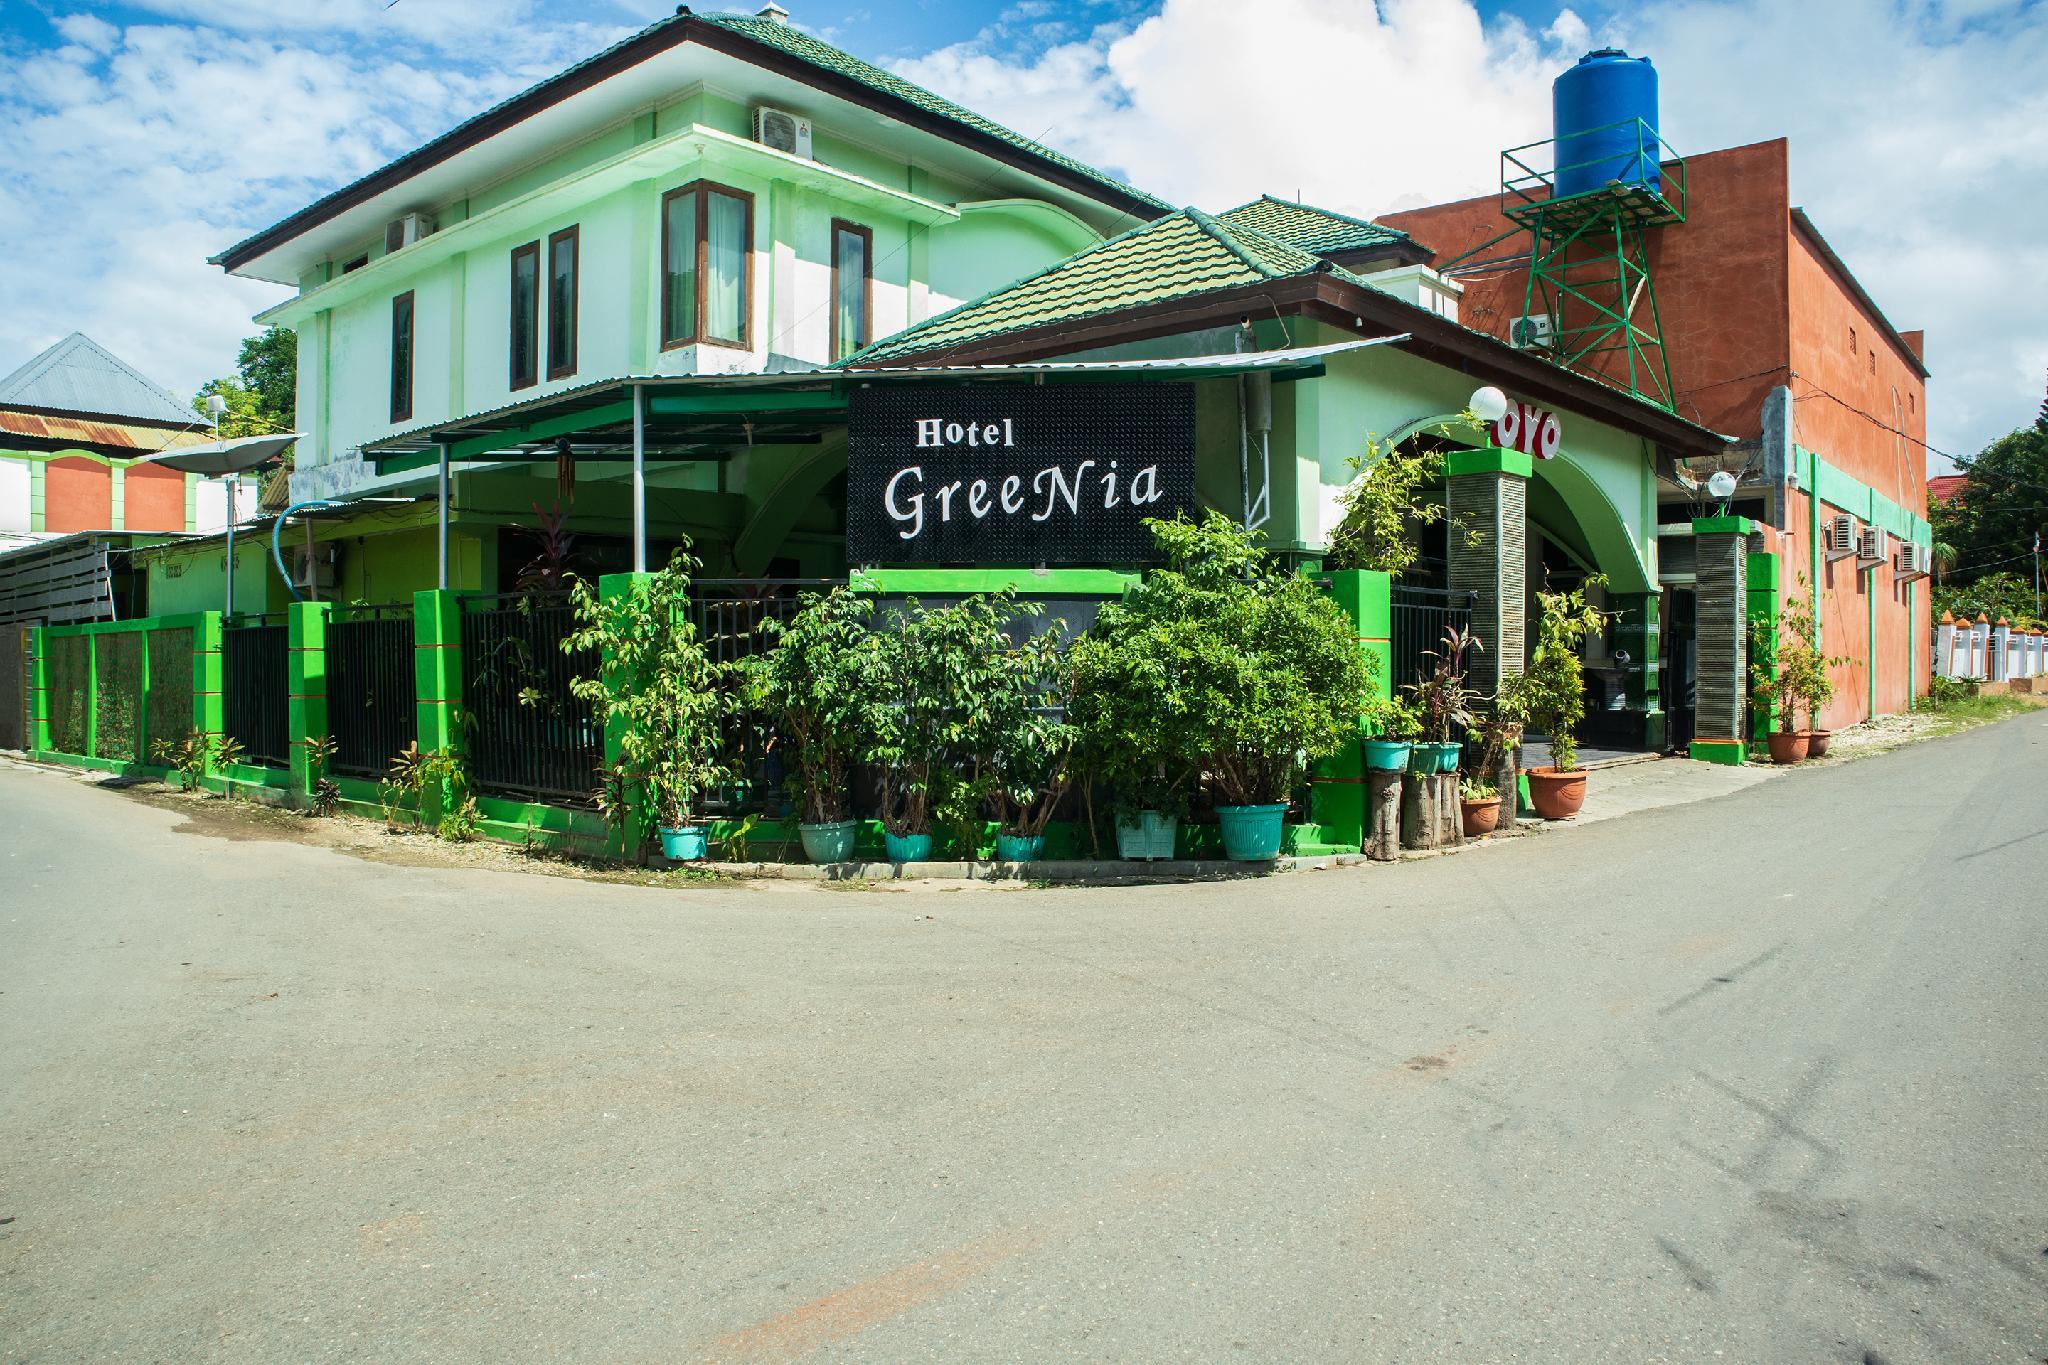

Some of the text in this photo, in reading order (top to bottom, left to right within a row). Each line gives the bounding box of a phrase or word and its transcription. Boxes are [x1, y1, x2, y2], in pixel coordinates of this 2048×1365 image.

[915, 418, 1015, 447] Hotel
[1497, 398, 1562, 460] OYO
[884, 460, 1163, 539] GreeNia
